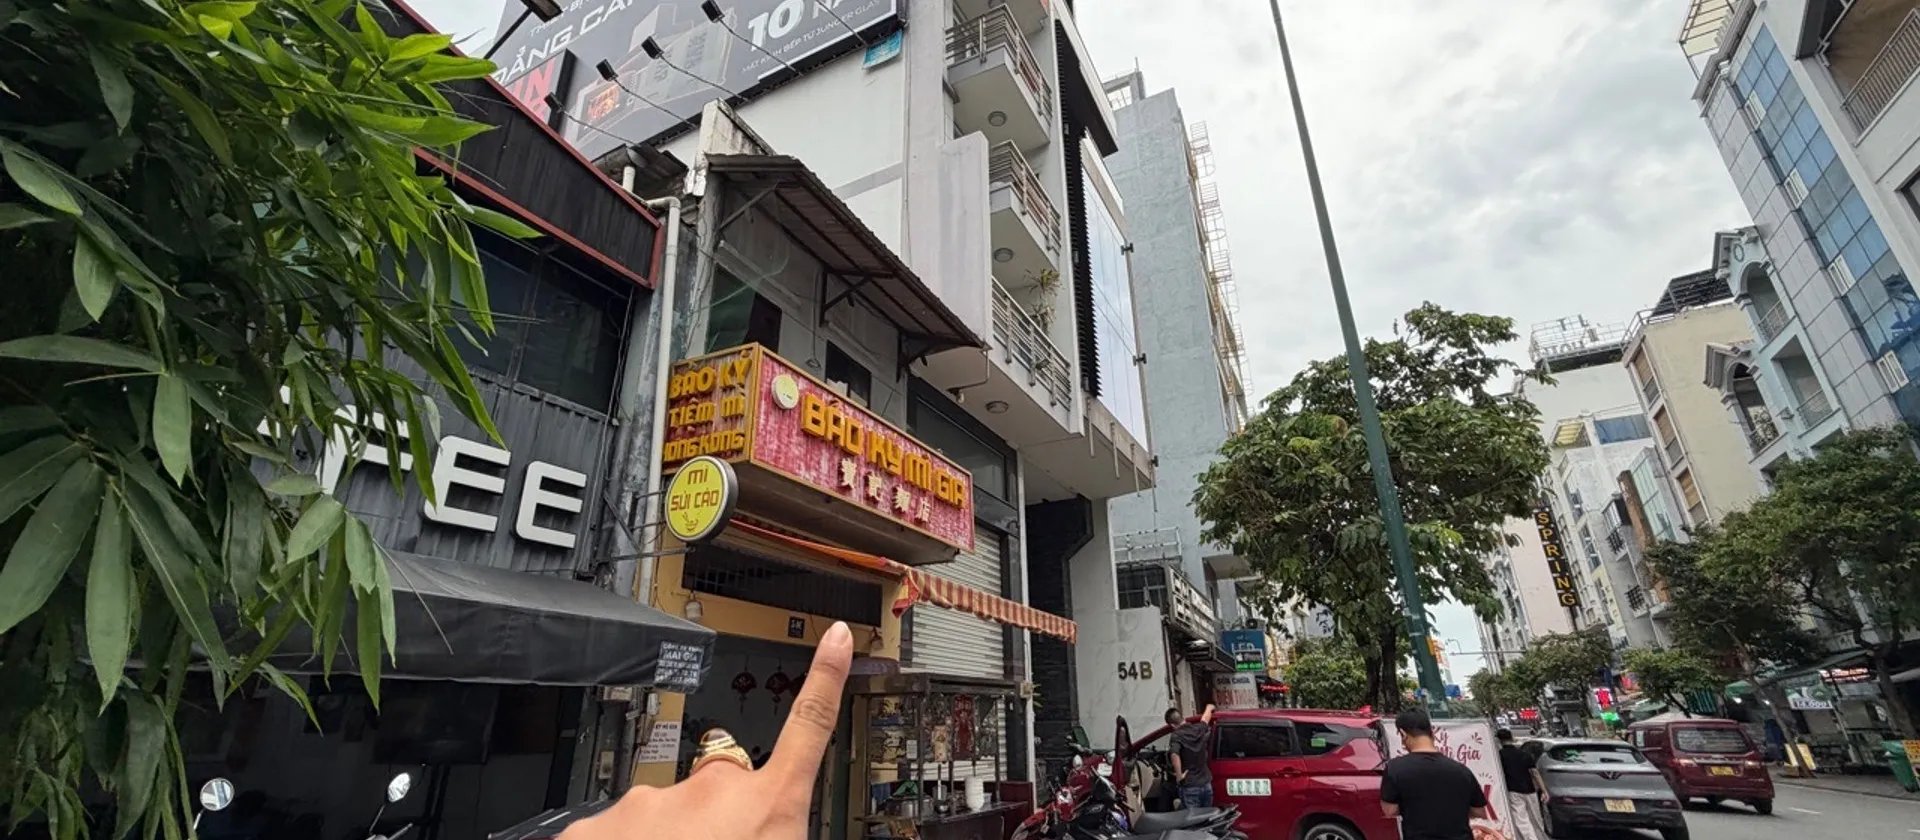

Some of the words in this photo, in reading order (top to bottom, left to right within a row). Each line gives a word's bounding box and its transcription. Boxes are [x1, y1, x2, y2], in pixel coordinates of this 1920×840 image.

[748, 0, 805, 52] 10
[256, 384, 588, 549] FEE
[801, 391, 864, 457] BẢO
[935, 468, 966, 508] GIA
[1537, 512, 1576, 606] SPRING
[1117, 660, 1153, 681] 54B
[1457, 743, 1482, 764] Gia
